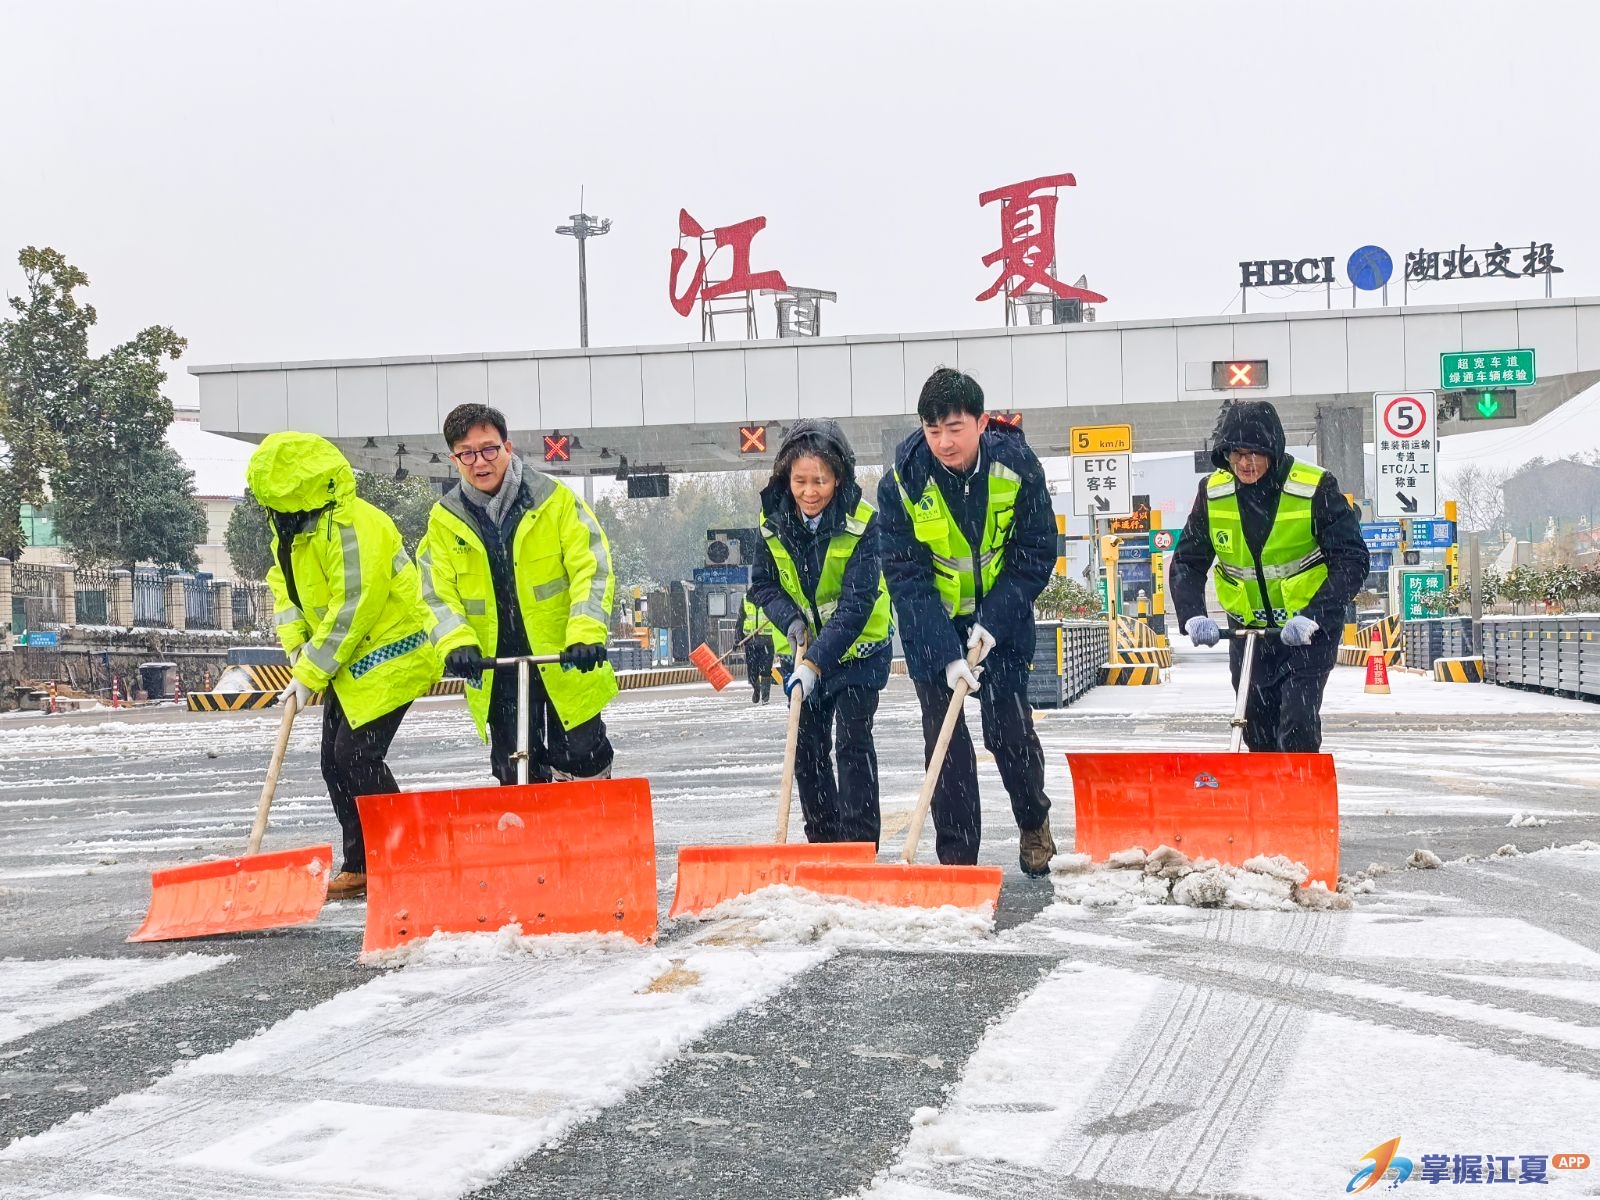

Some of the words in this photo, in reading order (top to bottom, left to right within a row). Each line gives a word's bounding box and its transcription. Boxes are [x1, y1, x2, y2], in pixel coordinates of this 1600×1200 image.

[669, 173, 1107, 317] 江夏
[1239, 256, 1335, 287] HBCI
[1407, 241, 1564, 281] 湖北交投
[1457, 355, 1519, 370] 超宽车道
[1448, 369, 1528, 384] 绿通车辆核验
[1397, 406, 1414, 430] 5
[1078, 432, 1090, 449] 5
[1099, 440, 1125, 448] km/h
[1380, 440, 1431, 451] 集装箱运输
[1396, 452, 1416, 462] 专道
[1084, 458, 1117, 473] ETC
[1381, 464, 1430, 474] ETC/人工
[1086, 476, 1117, 491] 客车
[1395, 477, 1417, 488] 称重
